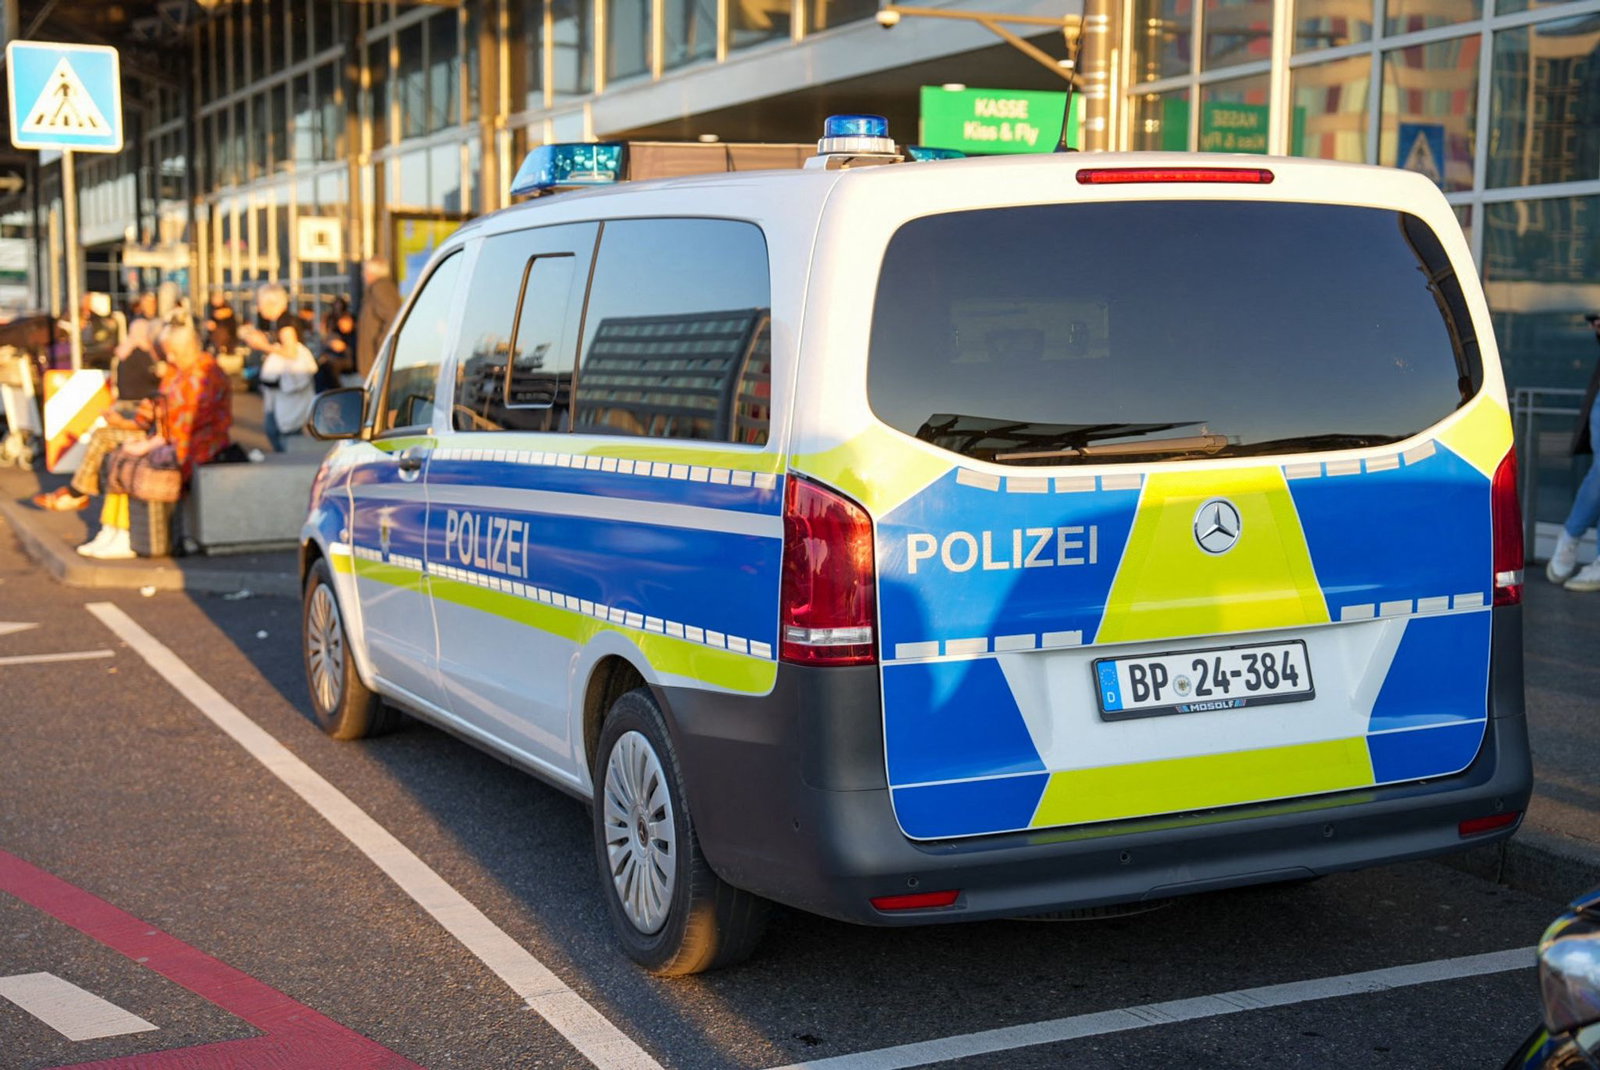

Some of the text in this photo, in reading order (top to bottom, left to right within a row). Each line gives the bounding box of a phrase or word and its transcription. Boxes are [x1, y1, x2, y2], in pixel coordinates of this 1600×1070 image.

[975, 97, 1029, 119] KASSE
[963, 120, 1039, 146] Kiss & Fly
[445, 508, 530, 579] POLIZEI
[906, 525, 1098, 575] POLIZEI
[1128, 650, 1299, 703] BP 24-384
[1106, 691, 1116, 703] D
[1190, 700, 1234, 713] MOSOLF
